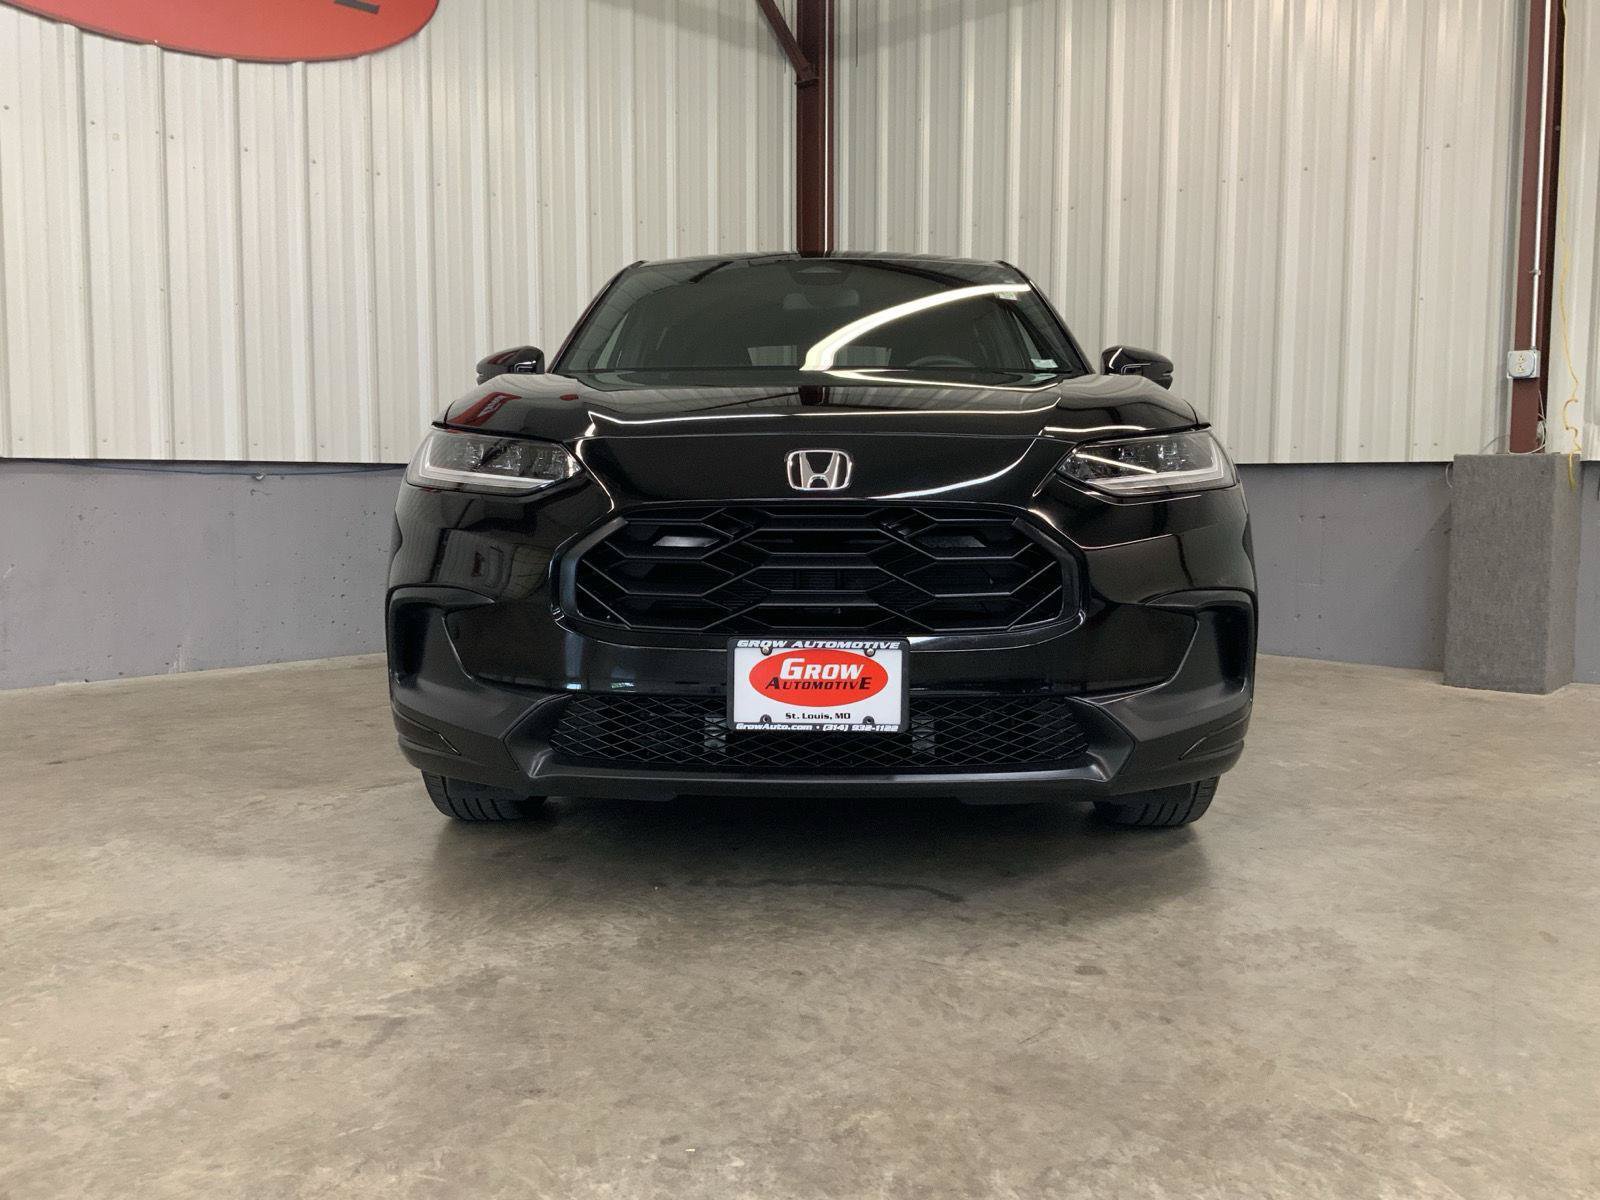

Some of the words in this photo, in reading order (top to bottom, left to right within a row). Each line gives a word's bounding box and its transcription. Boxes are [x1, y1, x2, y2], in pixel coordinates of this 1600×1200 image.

[737, 640, 787, 648] GROW
[791, 640, 901, 649] AUTOMOTIVE
[765, 676, 872, 690] AUTOMOTIVE
[785, 712, 800, 720] St.
[802, 712, 833, 720] Louis,
[835, 712, 851, 720] MO
[736, 723, 813, 731] GrowAuto.com
[822, 724, 849, 732] (314)
